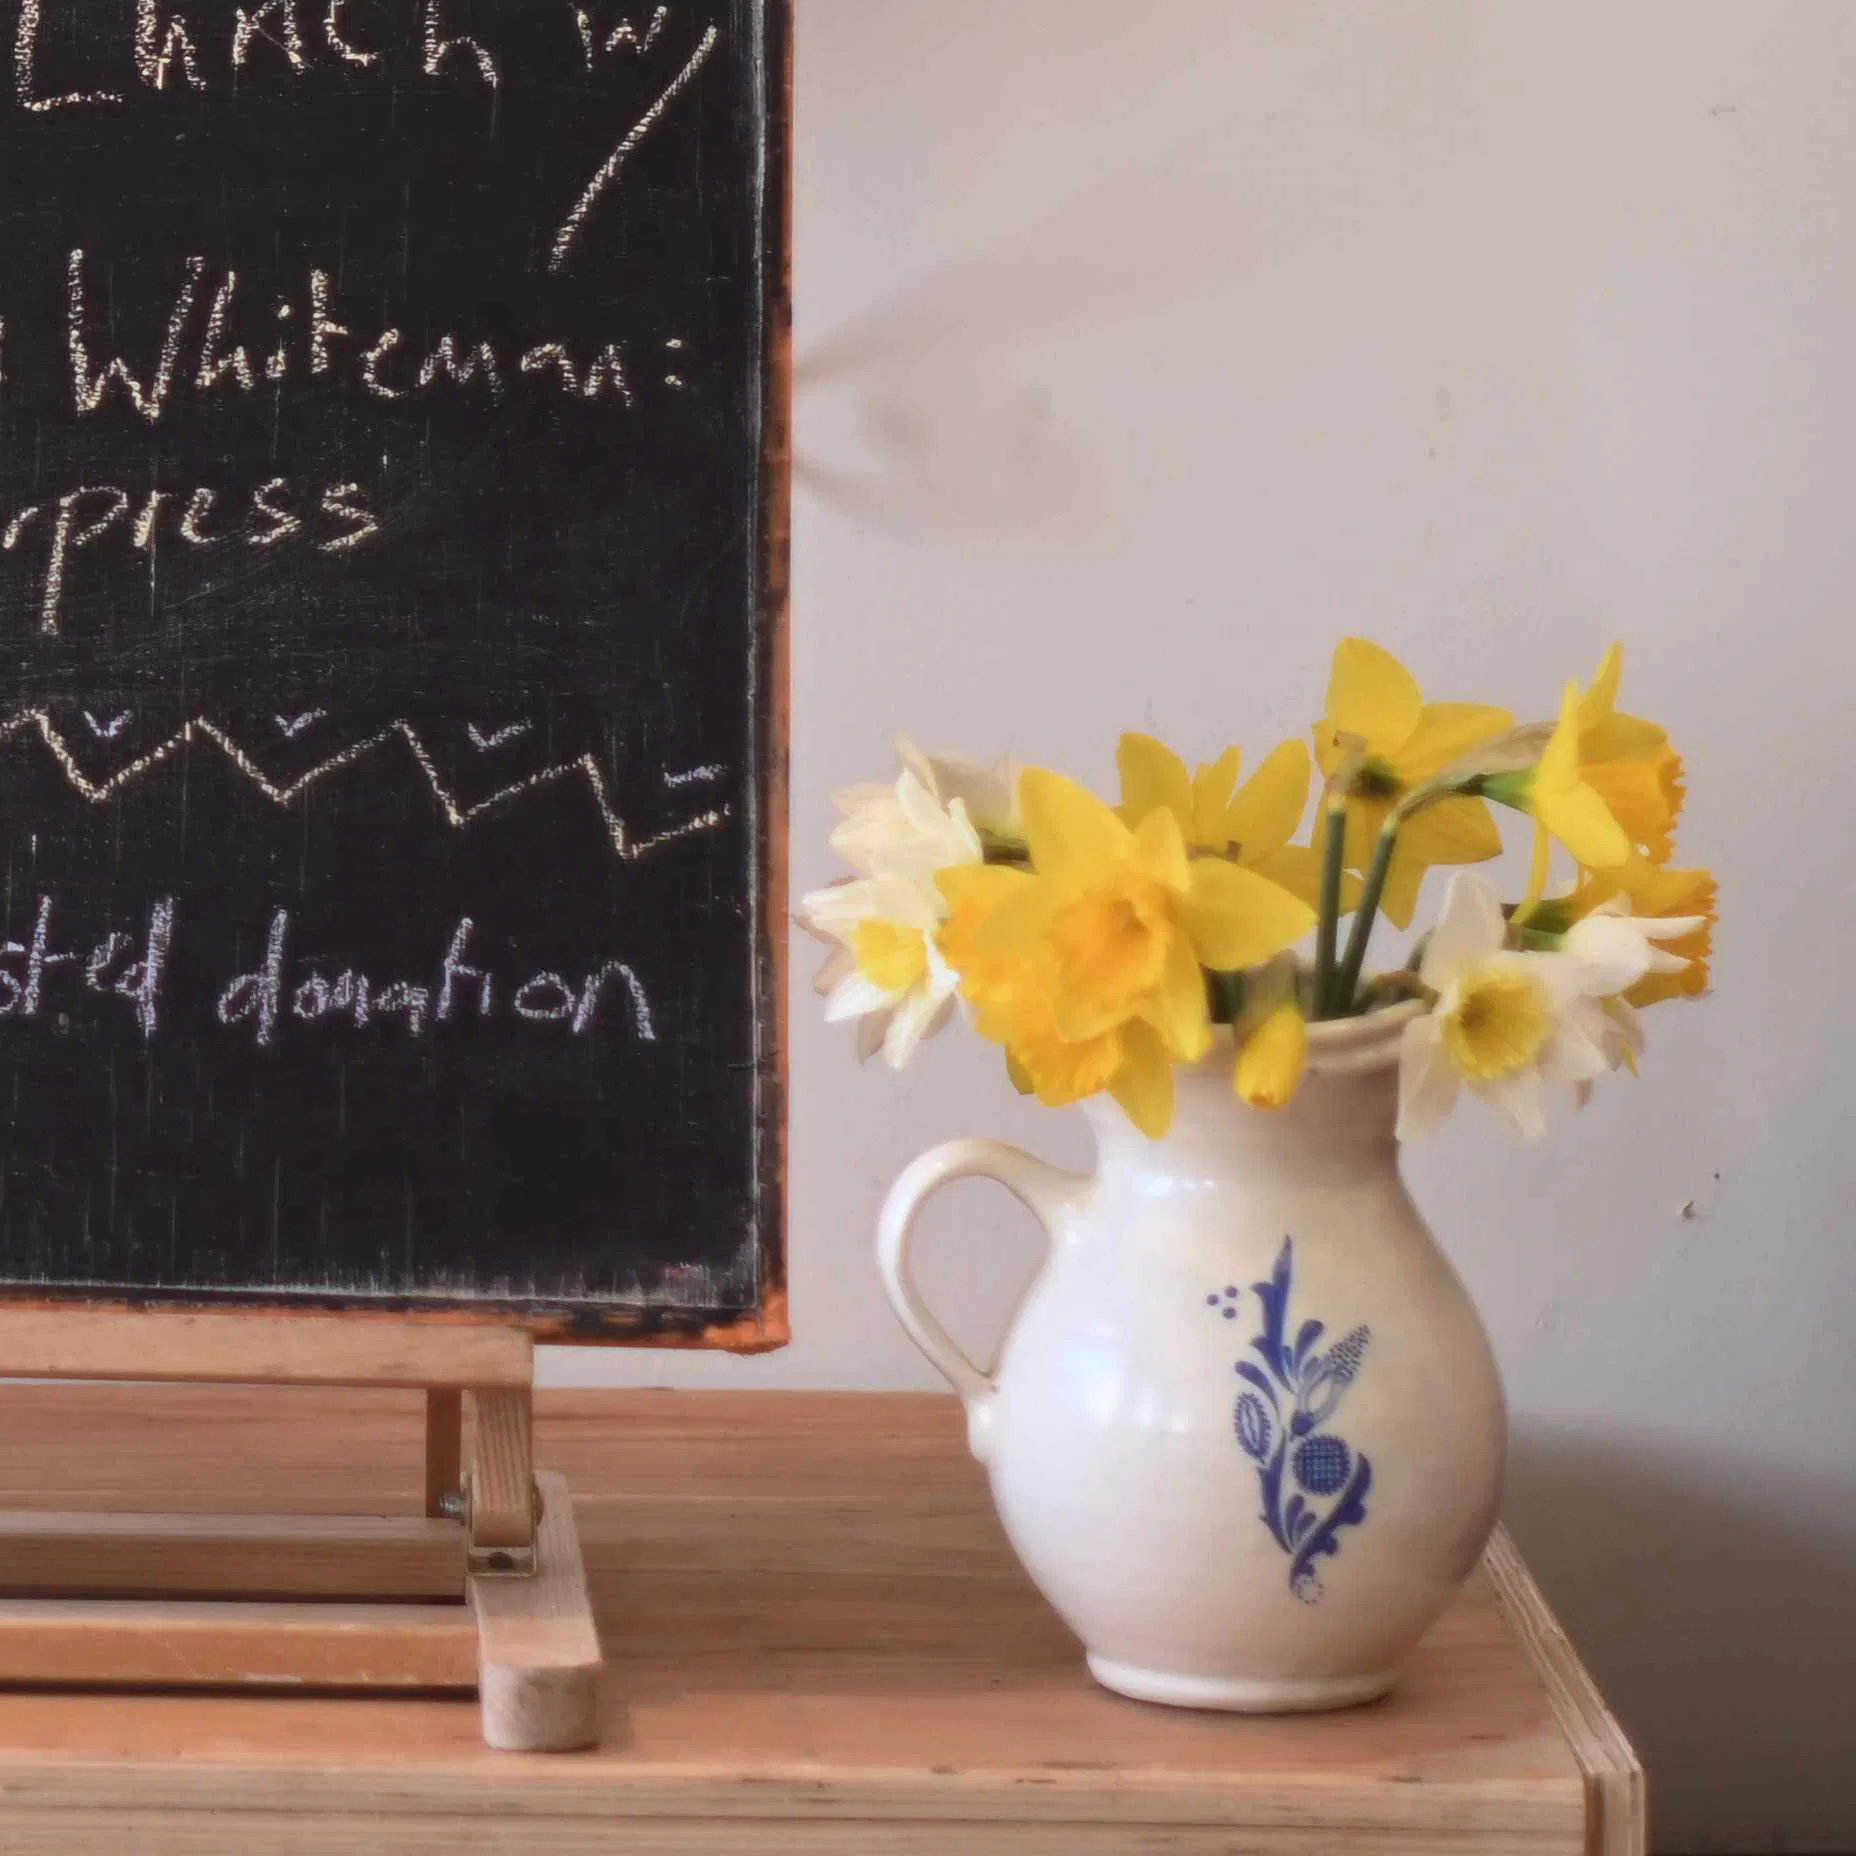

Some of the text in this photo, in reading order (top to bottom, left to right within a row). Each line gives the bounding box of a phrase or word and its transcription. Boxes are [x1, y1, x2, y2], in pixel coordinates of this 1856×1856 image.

[557, 1, 722, 274] w/
[66, 246, 685, 426] Whiteman:
[217, 907, 658, 1047] donation
